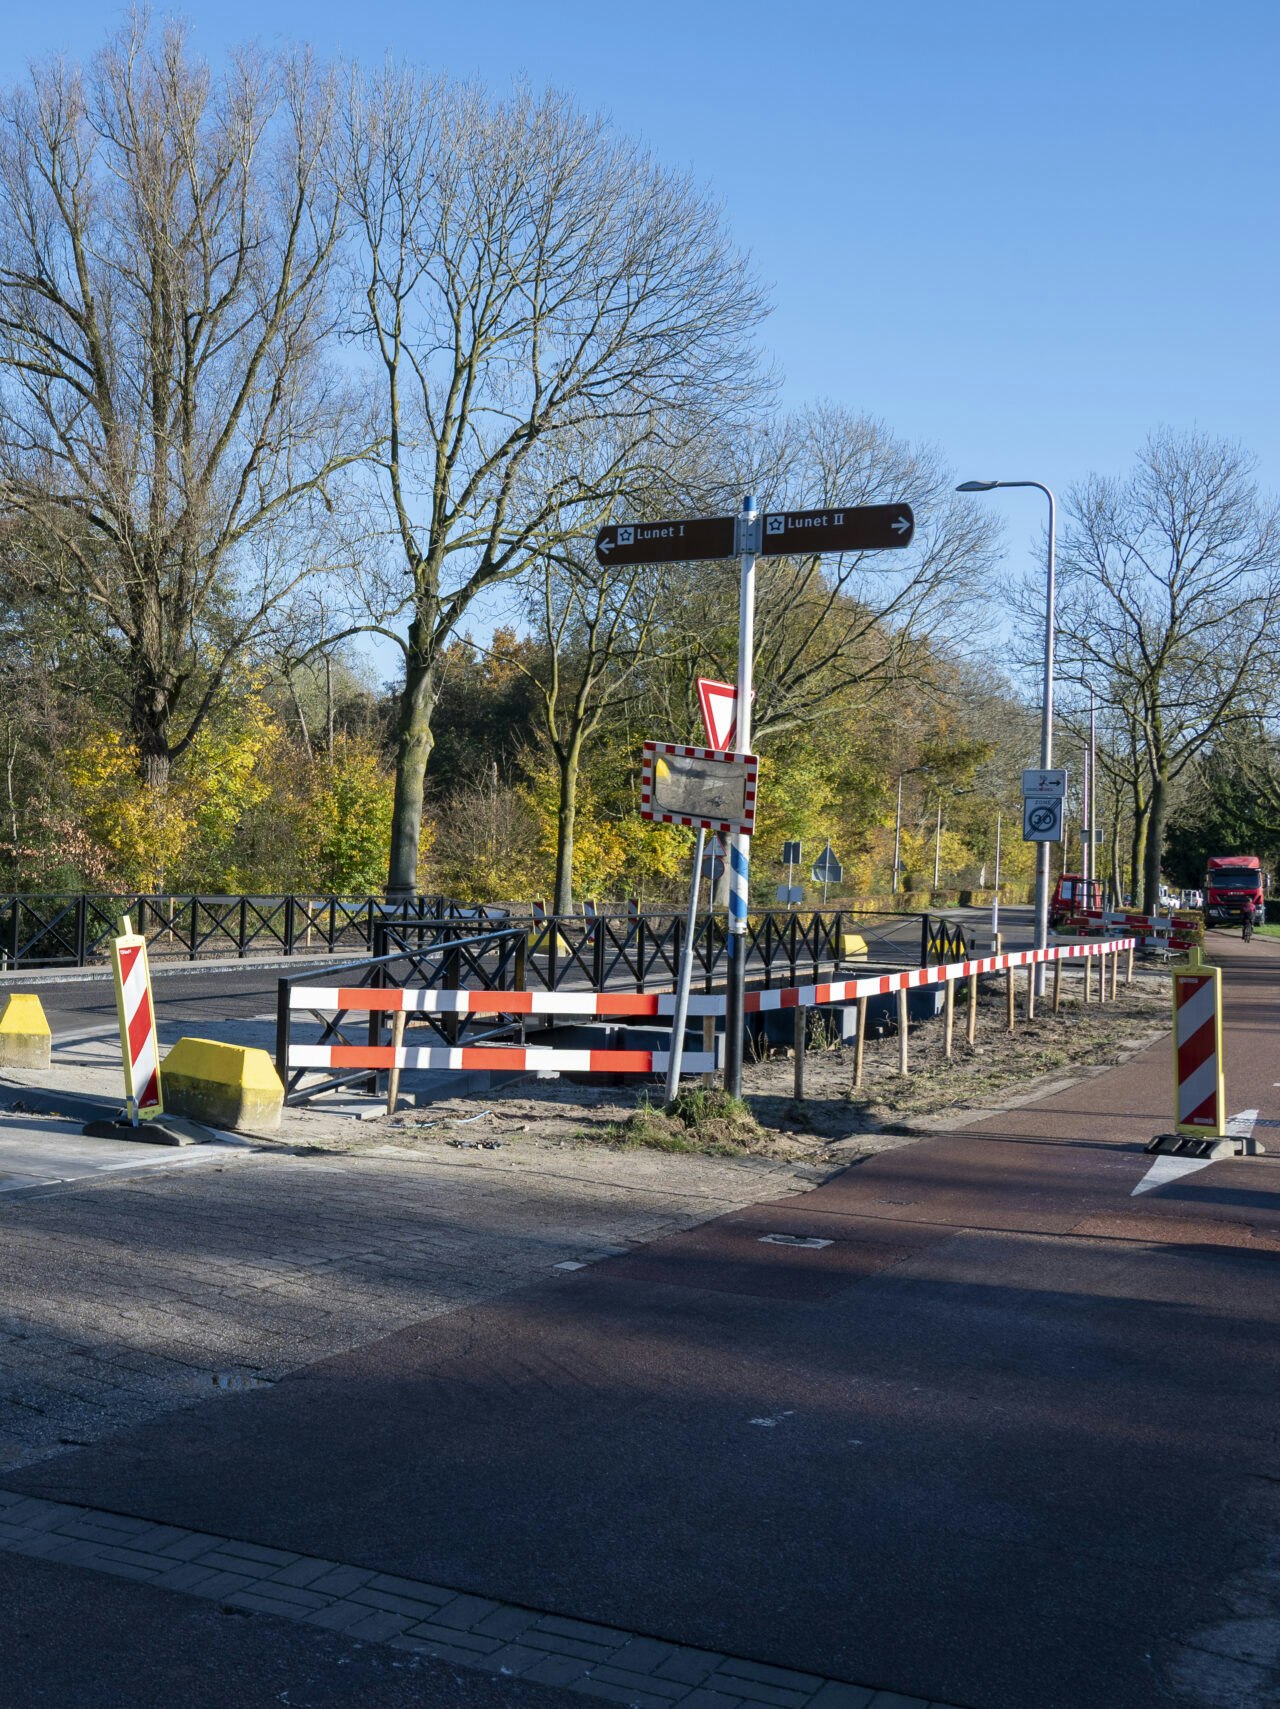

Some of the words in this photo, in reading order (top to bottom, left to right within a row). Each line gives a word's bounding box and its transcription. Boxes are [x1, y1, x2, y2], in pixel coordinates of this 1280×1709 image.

[788, 515, 828, 528] Lunet
[833, 513, 844, 525] II
[637, 526, 674, 539] Lunet
[679, 525, 685, 537] I
[1033, 814, 1052, 825] 30
